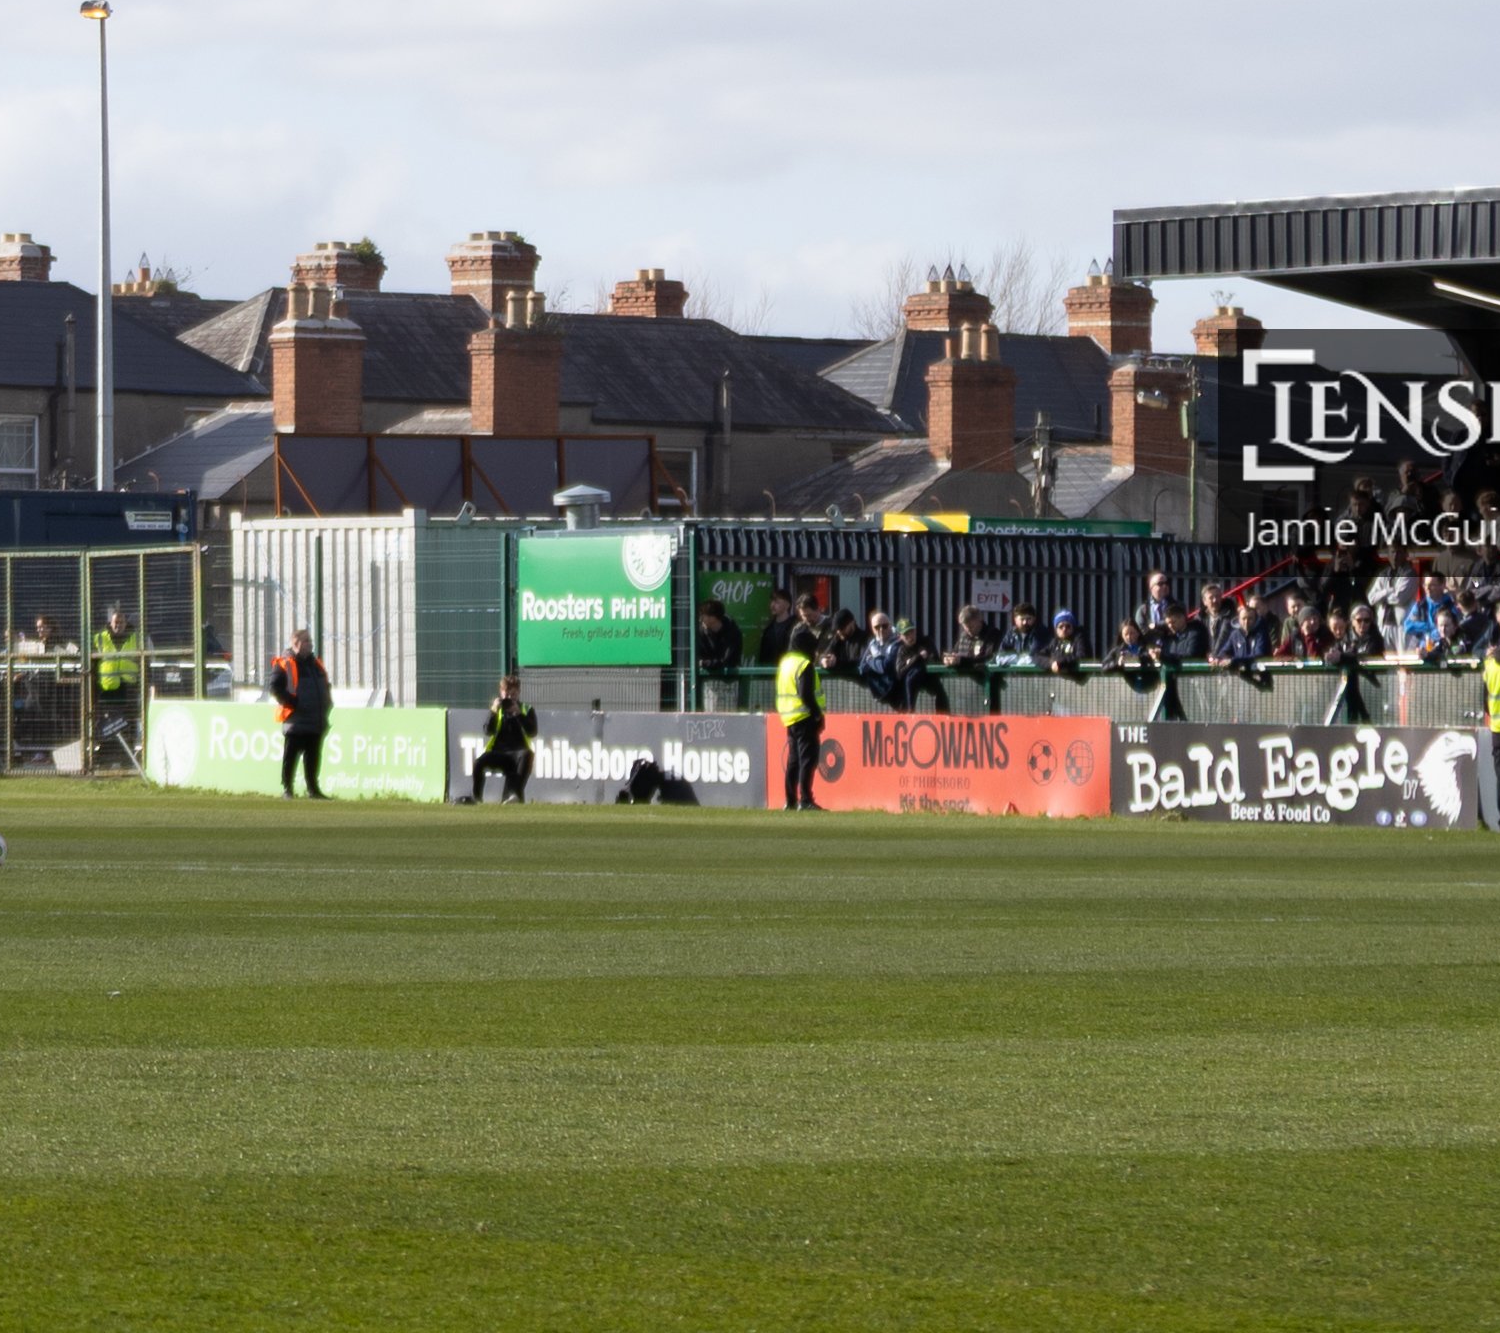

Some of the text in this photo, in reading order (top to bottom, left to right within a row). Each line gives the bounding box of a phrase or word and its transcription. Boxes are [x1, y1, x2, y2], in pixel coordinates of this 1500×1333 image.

[522, 591, 666, 622] Roosters Piri Piri
[587, 626, 614, 642] grilled
[633, 626, 665, 641] healthy
[1118, 726, 1149, 744] THE
[353, 735, 386, 767] Piri
[393, 736, 427, 768] Piri
[663, 740, 751, 784] House
[899, 775, 971, 790] OF PHIBSBORO
[1126, 726, 1419, 813] Bald Eagle D7
[1230, 802, 1331, 823] Beer & Food Co
